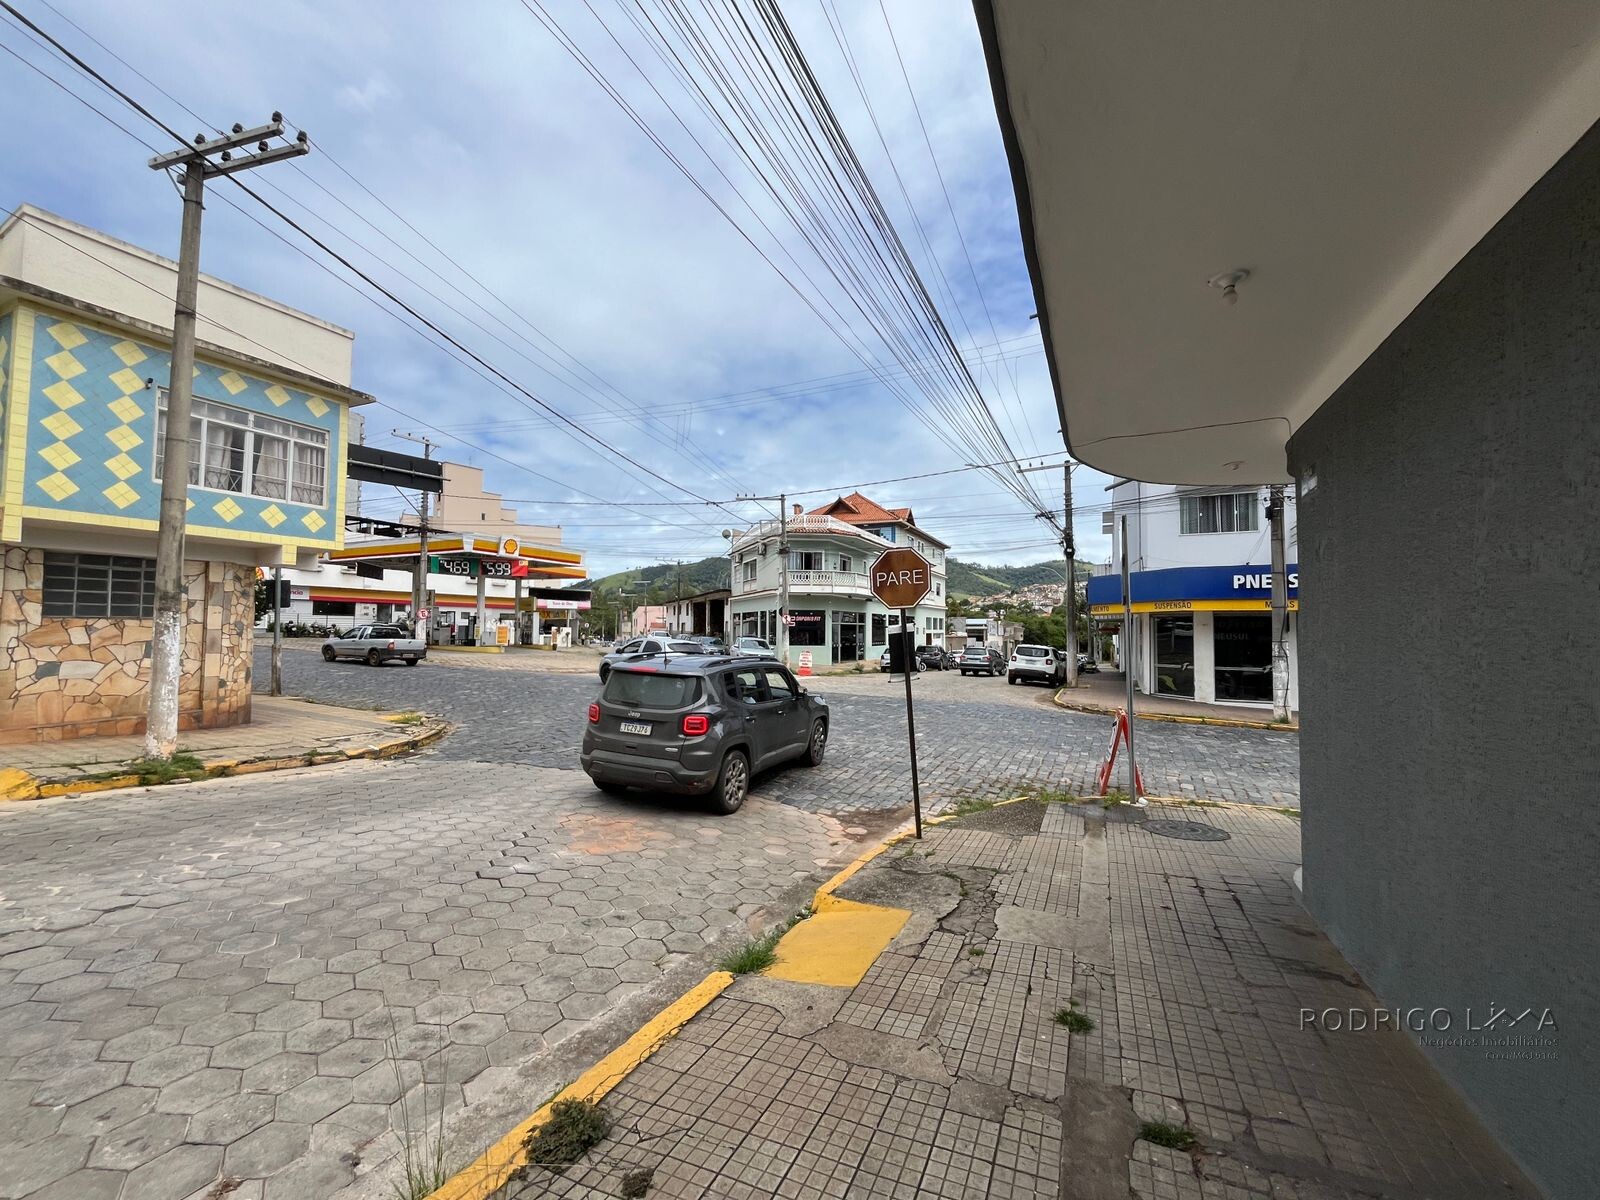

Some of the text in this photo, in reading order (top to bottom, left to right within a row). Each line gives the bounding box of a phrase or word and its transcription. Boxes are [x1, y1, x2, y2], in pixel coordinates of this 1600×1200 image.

[486, 562, 511, 575] 5.99
[876, 569, 924, 587] PARE
[1233, 573, 1298, 588] PNES
